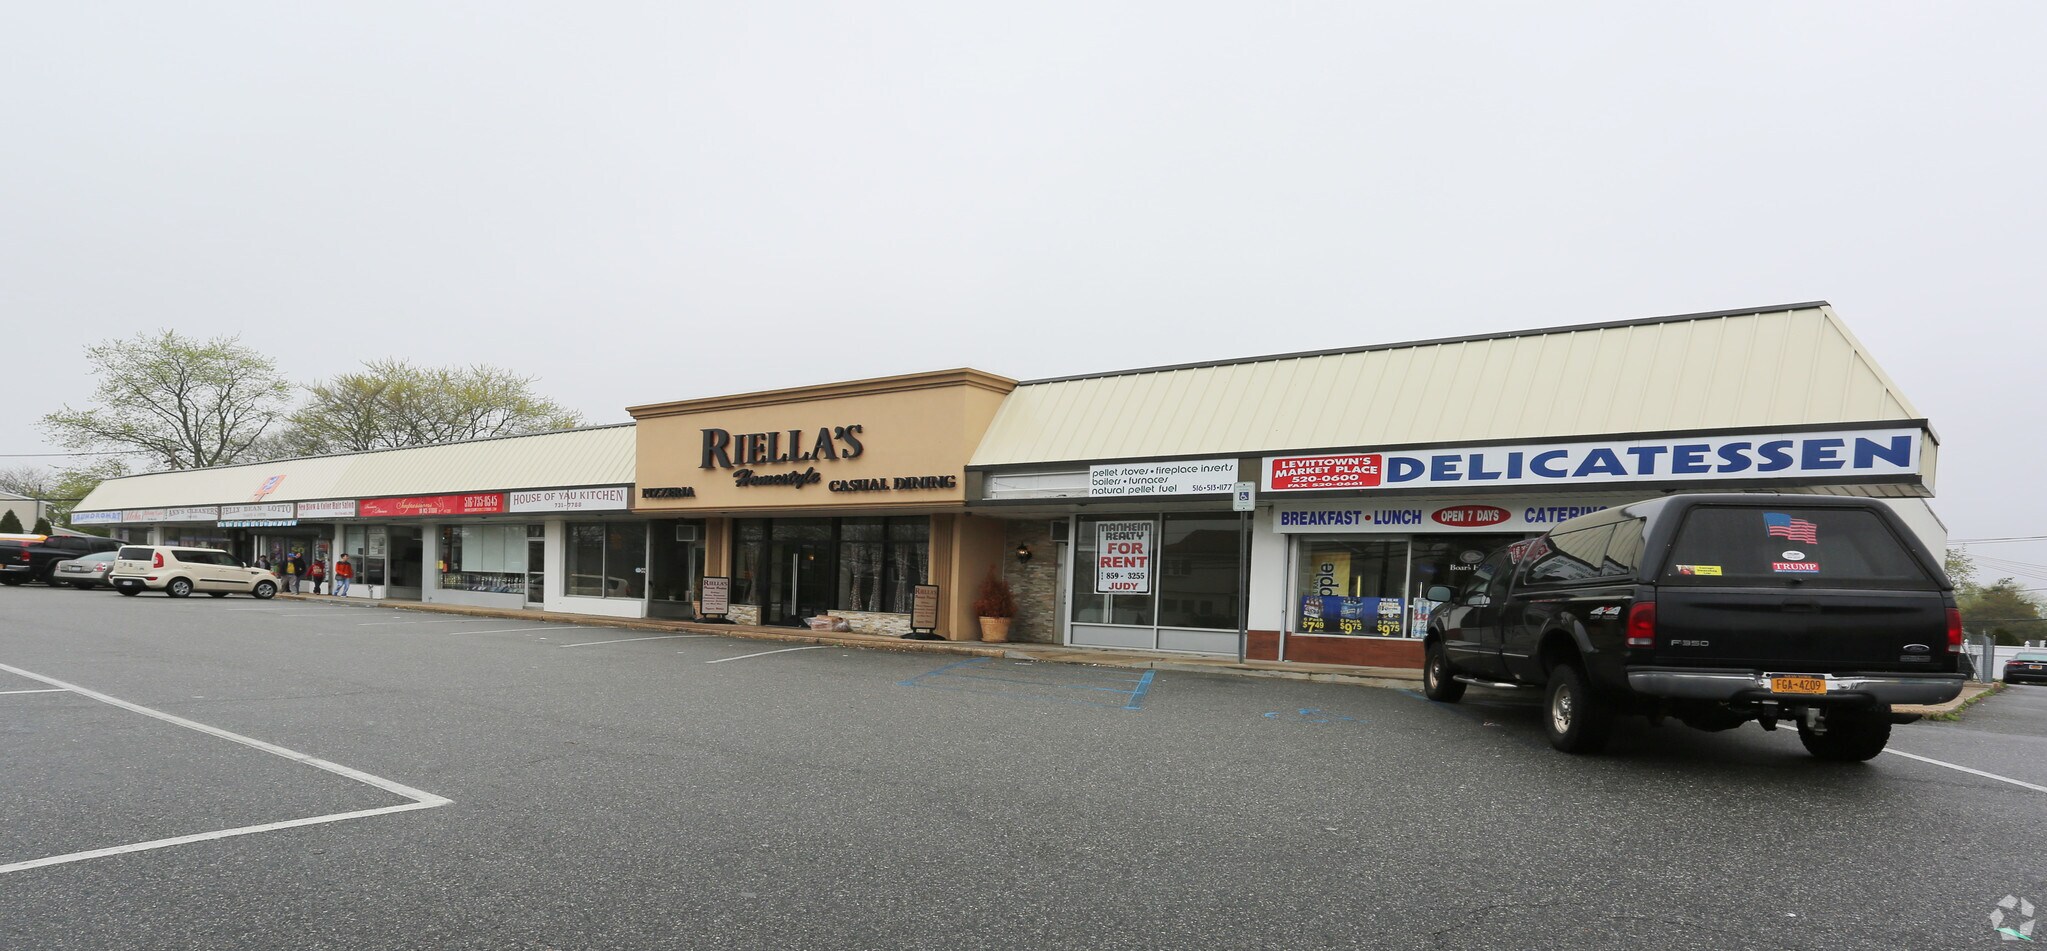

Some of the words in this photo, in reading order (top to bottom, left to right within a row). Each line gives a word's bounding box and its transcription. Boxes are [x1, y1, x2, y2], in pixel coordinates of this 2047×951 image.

[699, 424, 863, 469] RIELLA'S
[1281, 457, 1371, 469] LEVITTOWN'S
[1386, 436, 1912, 482] DELICATESSEN
[1092, 469, 1118, 477] pellet
[1120, 468, 1149, 476] stoves
[1156, 466, 1198, 475] fireplace
[1201, 463, 1234, 472] inserts
[1275, 467, 1330, 478] MARKET
[1335, 466, 1378, 474] PLACE
[732, 467, 822, 489] Homestyle
[1128, 476, 1169, 484] furnaces
[1292, 474, 1359, 483] 520-0600
[828, 478, 890, 493] CASUAL
[893, 475, 956, 490] DINING
[641, 487, 695, 498] PIZZERIA
[1092, 487, 1125, 495] natural
[1128, 485, 1155, 494] pellet
[1159, 485, 1178, 493] fuel
[513, 494, 542, 505] HOUSE
[544, 493, 556, 501] OF
[559, 492, 577, 500] YAU
[580, 489, 624, 501] KITCHEN
[187, 507, 219, 515] CLEANERS
[222, 507, 241, 515] JELLY
[267, 505, 292, 513] LOTTO
[72, 512, 121, 521] LAUNDROMAT
[1281, 511, 1362, 525] BREAKFAST
[1374, 509, 1422, 524] LUNCH
[1441, 510, 1464, 522] OPEN
[1468, 511, 1473, 521] 7
[1476, 510, 1499, 521] DAYS
[1098, 523, 1152, 531] MANHEIM
[1106, 532, 1144, 540] REALTY
[1107, 543, 1143, 554] FOR
[1100, 557, 1147, 568] RENT
